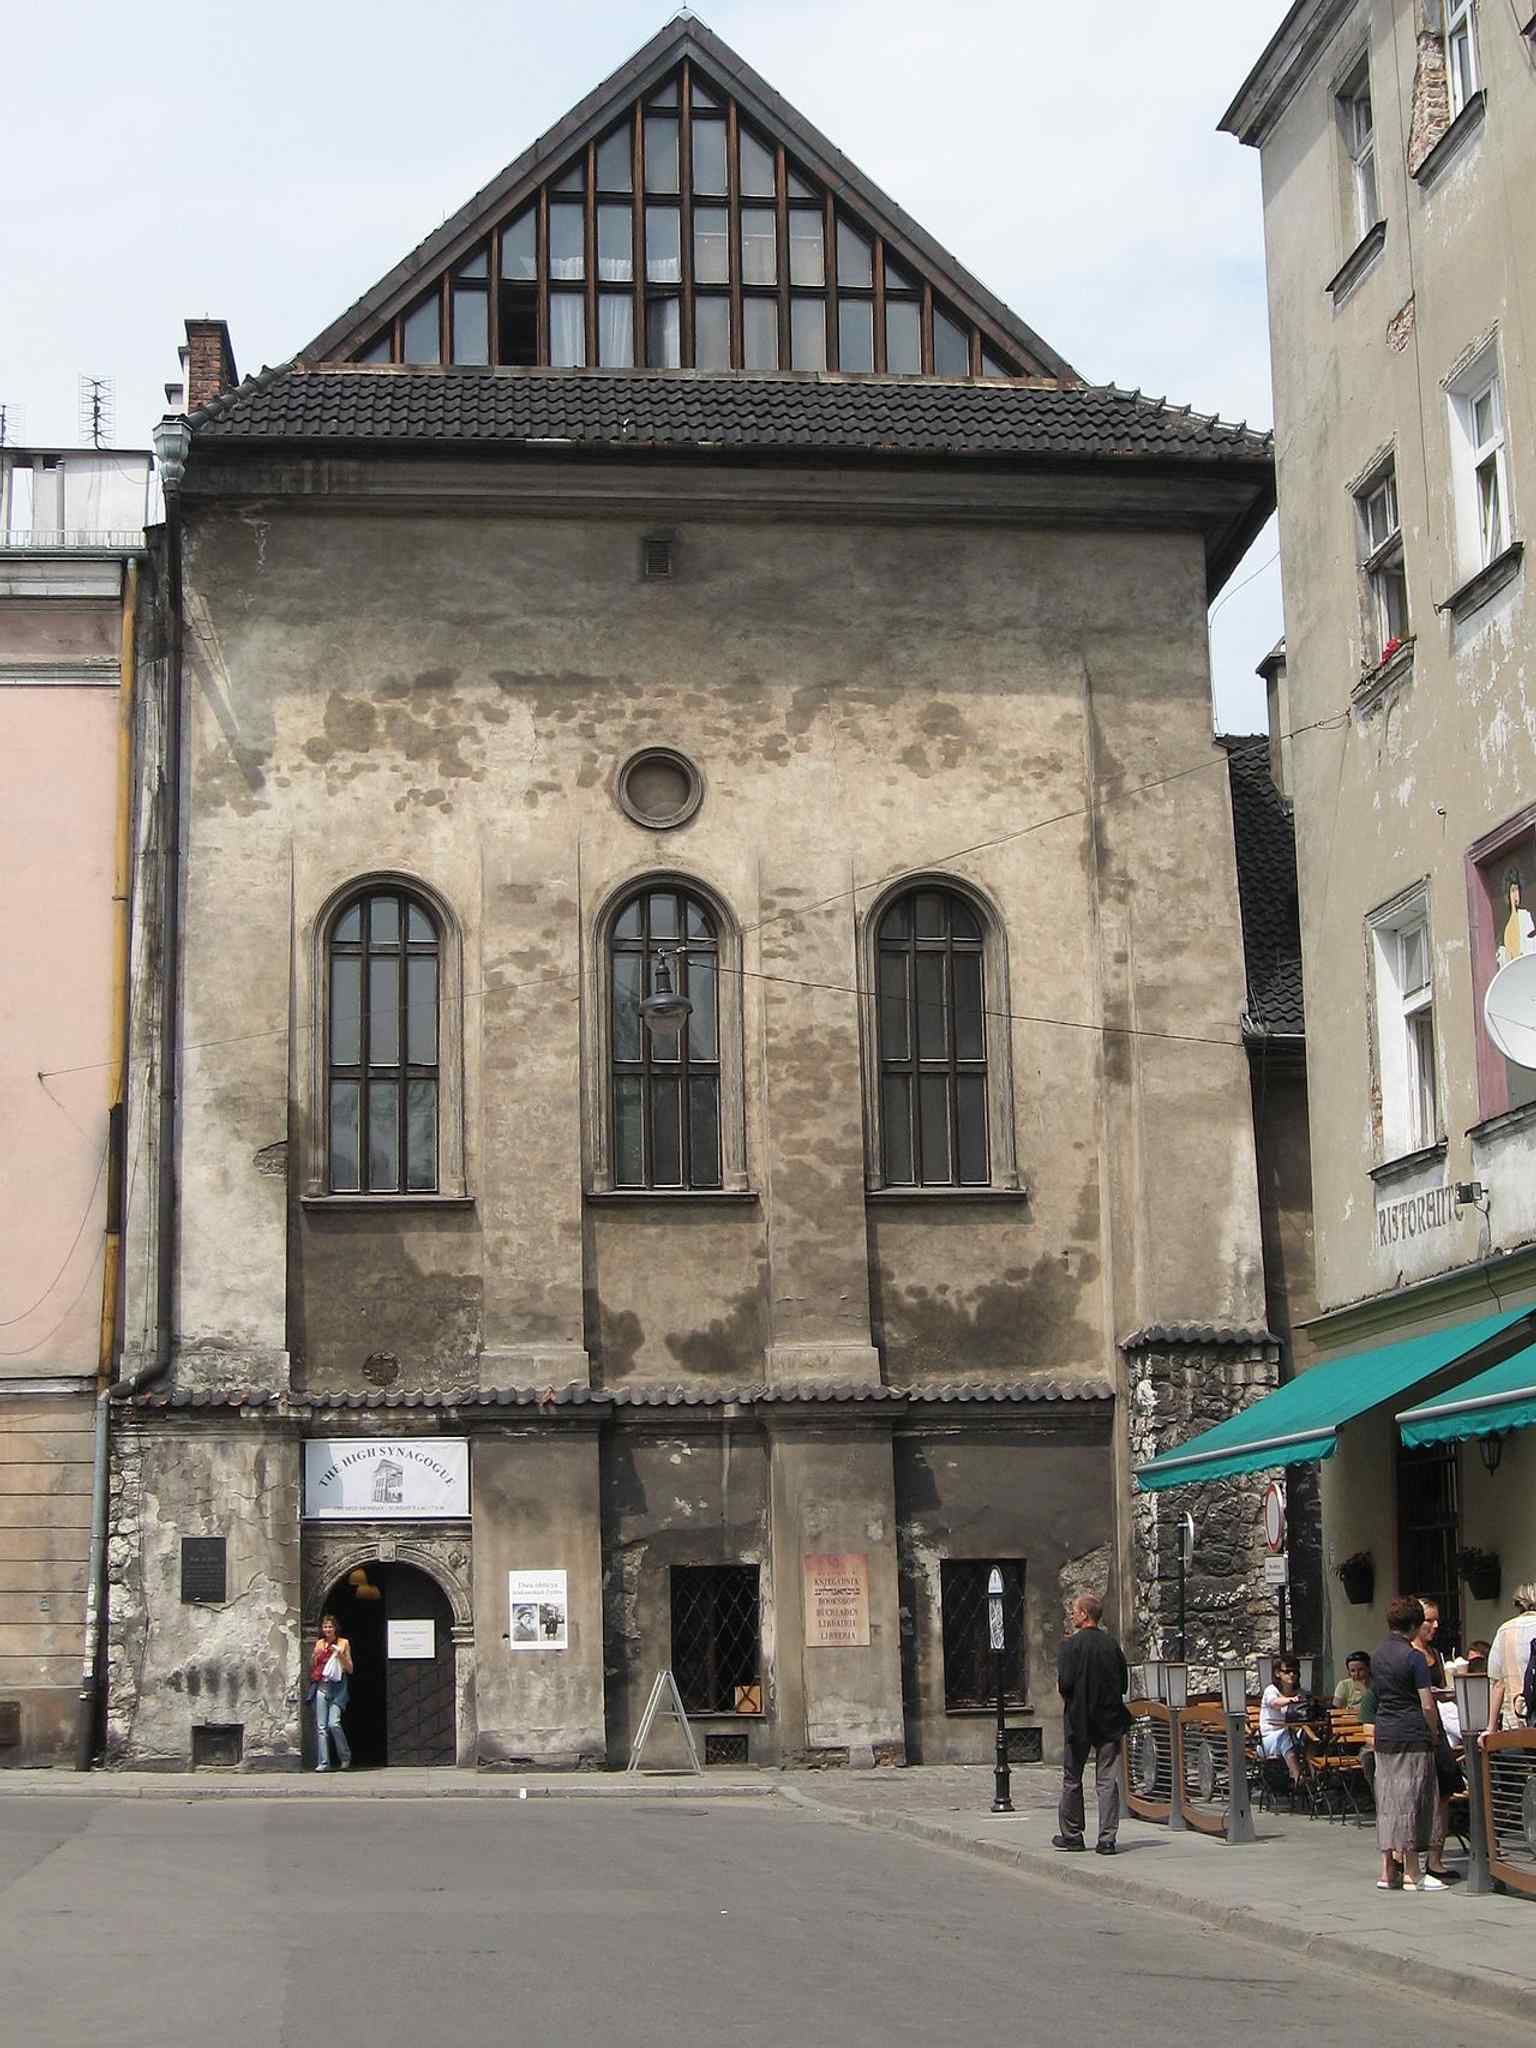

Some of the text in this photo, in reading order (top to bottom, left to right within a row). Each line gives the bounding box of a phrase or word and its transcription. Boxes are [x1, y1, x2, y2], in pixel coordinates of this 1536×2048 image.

[319, 1446, 456, 1488] THE HIGH SYNAGOGUE
[818, 1597, 857, 1606] BOOKSHOP
